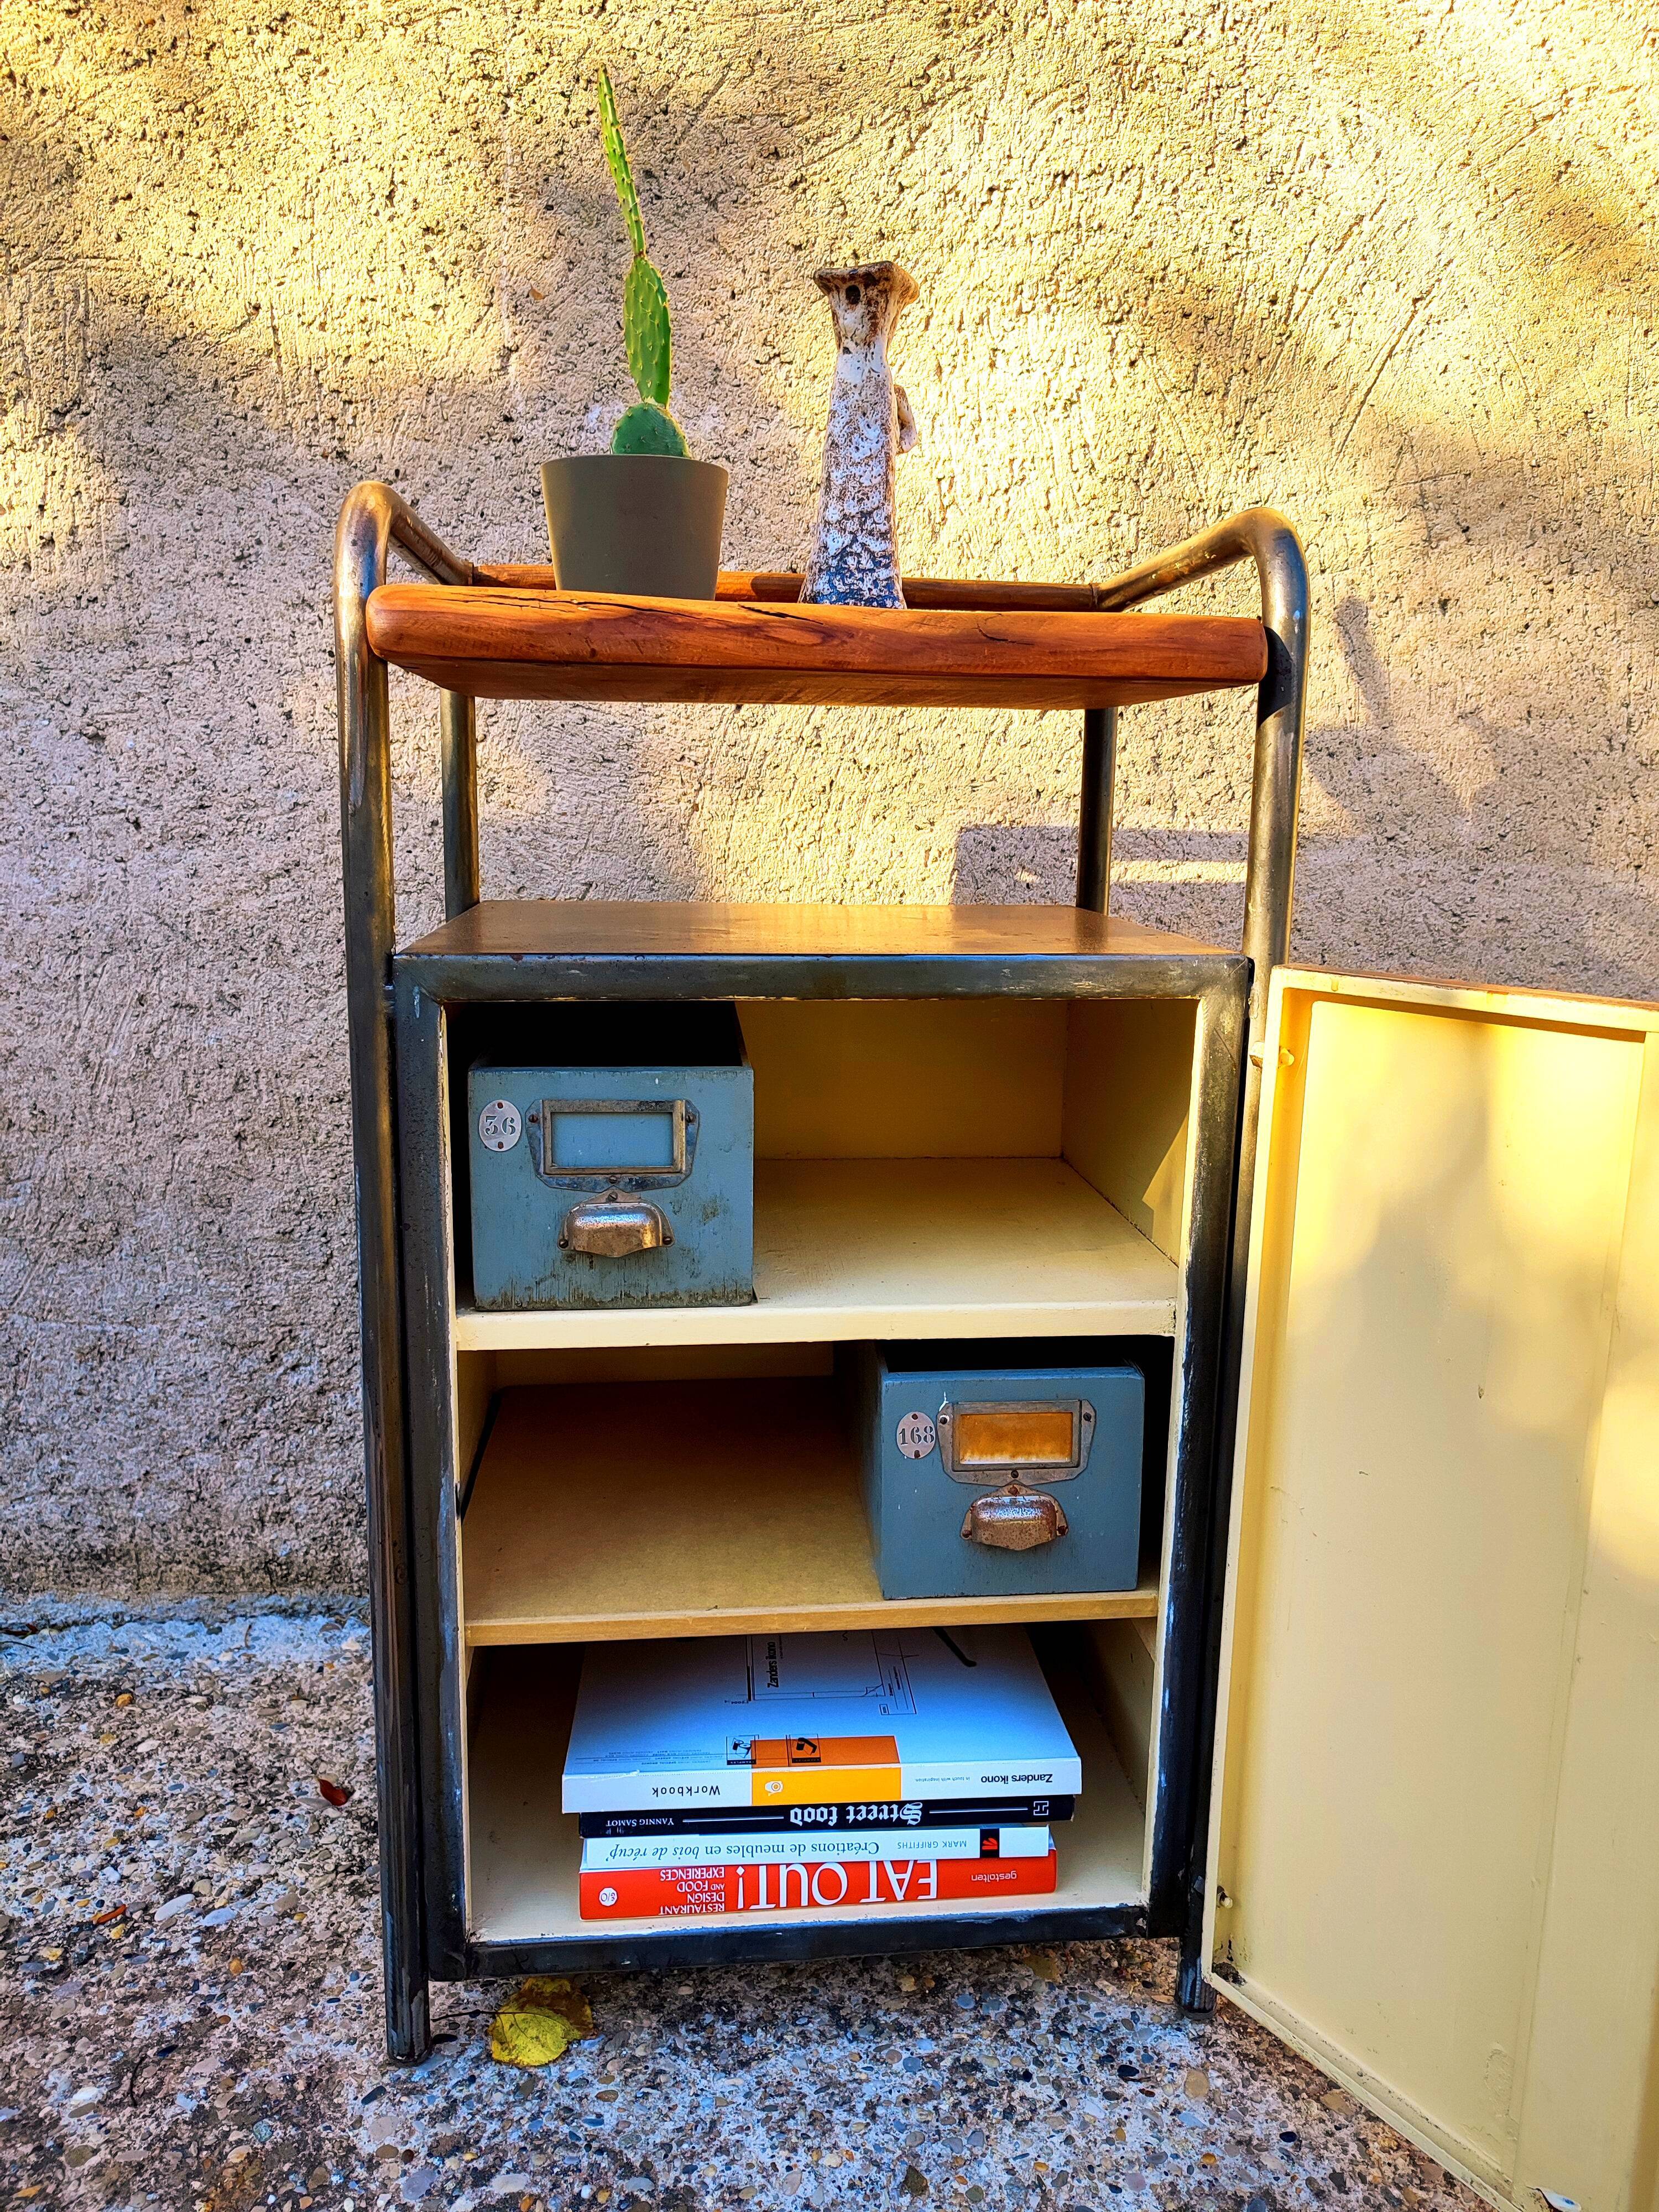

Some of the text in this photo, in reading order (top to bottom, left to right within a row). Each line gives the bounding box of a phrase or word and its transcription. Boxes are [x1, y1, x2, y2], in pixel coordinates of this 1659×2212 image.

[484, 1115, 516, 1135] 36
[899, 1426, 935, 1445] 168
[980, 1773, 1053, 1785] Zanders ikono
[651, 1786, 721, 1797] Workbook
[790, 1802, 923, 1826] Street food
[639, 1818, 674, 1826] YANNIG
[705, 1846, 721, 1856] en
[790, 1843, 806, 1857] de
[811, 1841, 879, 1856] Créations
[897, 1840, 938, 1849] GRIFFITHS
[653, 1848, 668, 1861] de
[672, 1846, 700, 1860] bois
[726, 1844, 784, 1859] meubles
[659, 1866, 725, 1881] EXPERIENCES
[971, 1870, 1017, 1882] gestalten
[676, 1880, 709, 1893] FOOD
[735, 1859, 938, 1910] EAT OUT!
[686, 1891, 725, 1903] DESIGN
[658, 1903, 725, 1916] RESTAURANT
